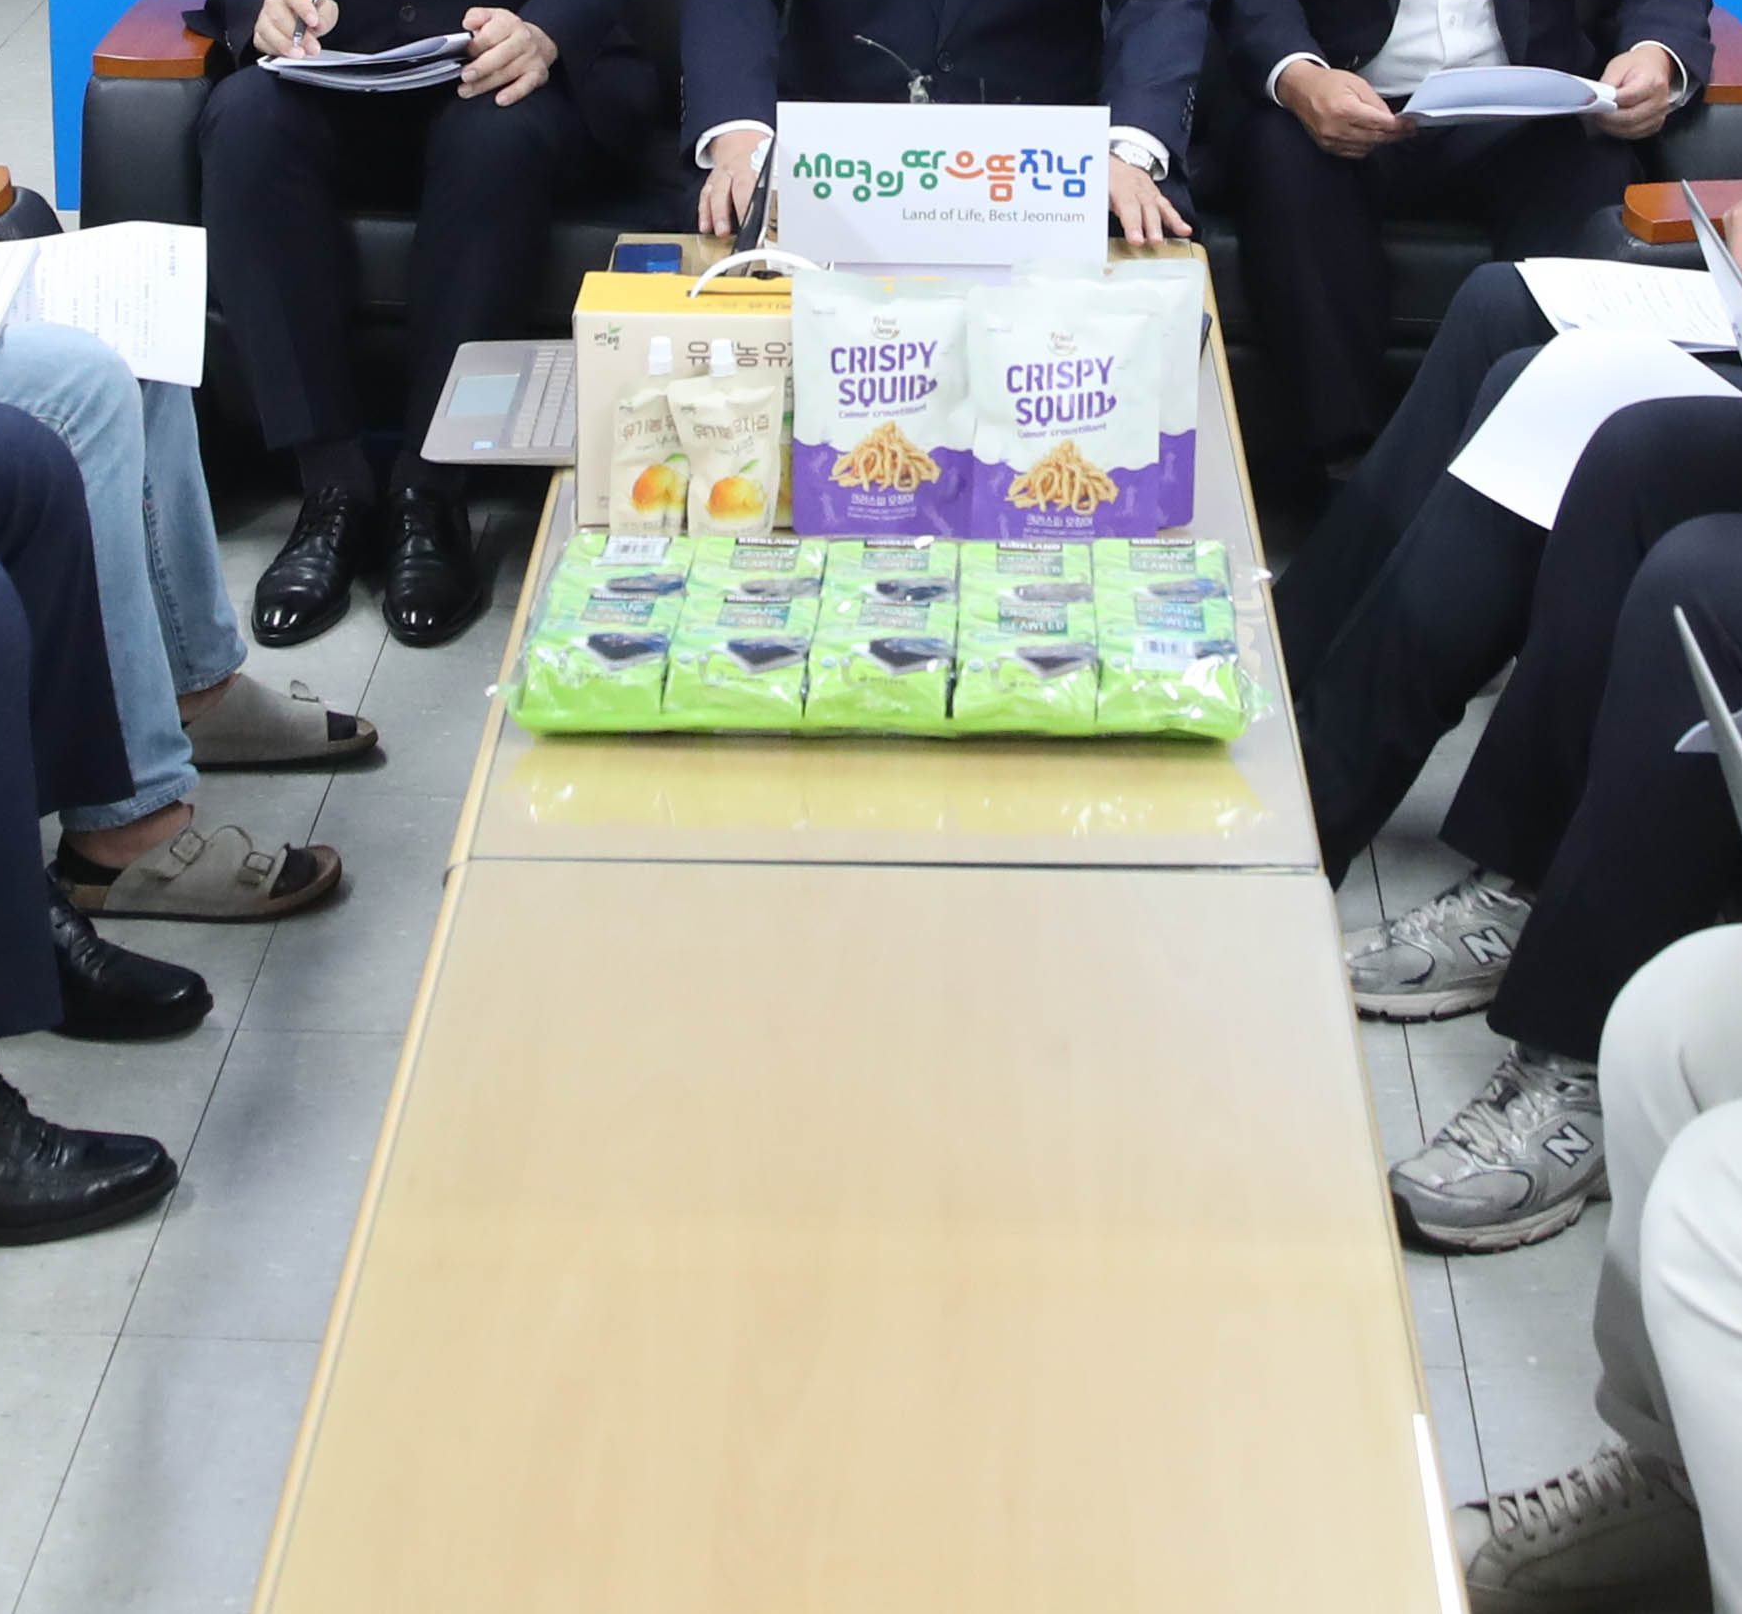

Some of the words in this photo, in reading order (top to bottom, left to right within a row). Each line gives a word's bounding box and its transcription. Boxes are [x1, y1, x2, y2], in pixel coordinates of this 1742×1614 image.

[901, 207, 937, 222] Land
[939, 207, 957, 222] of
[956, 208, 986, 224] Life,
[988, 209, 1019, 223] Best
[1020, 208, 1086, 224] Jeonnam
[830, 340, 939, 375] CRISPY
[1006, 355, 1116, 393] CRISPY
[837, 373, 939, 408] SQUID
[1015, 390, 1118, 427] SQUID
[1459, 926, 1513, 966] N
[1542, 1121, 1595, 1169] N
